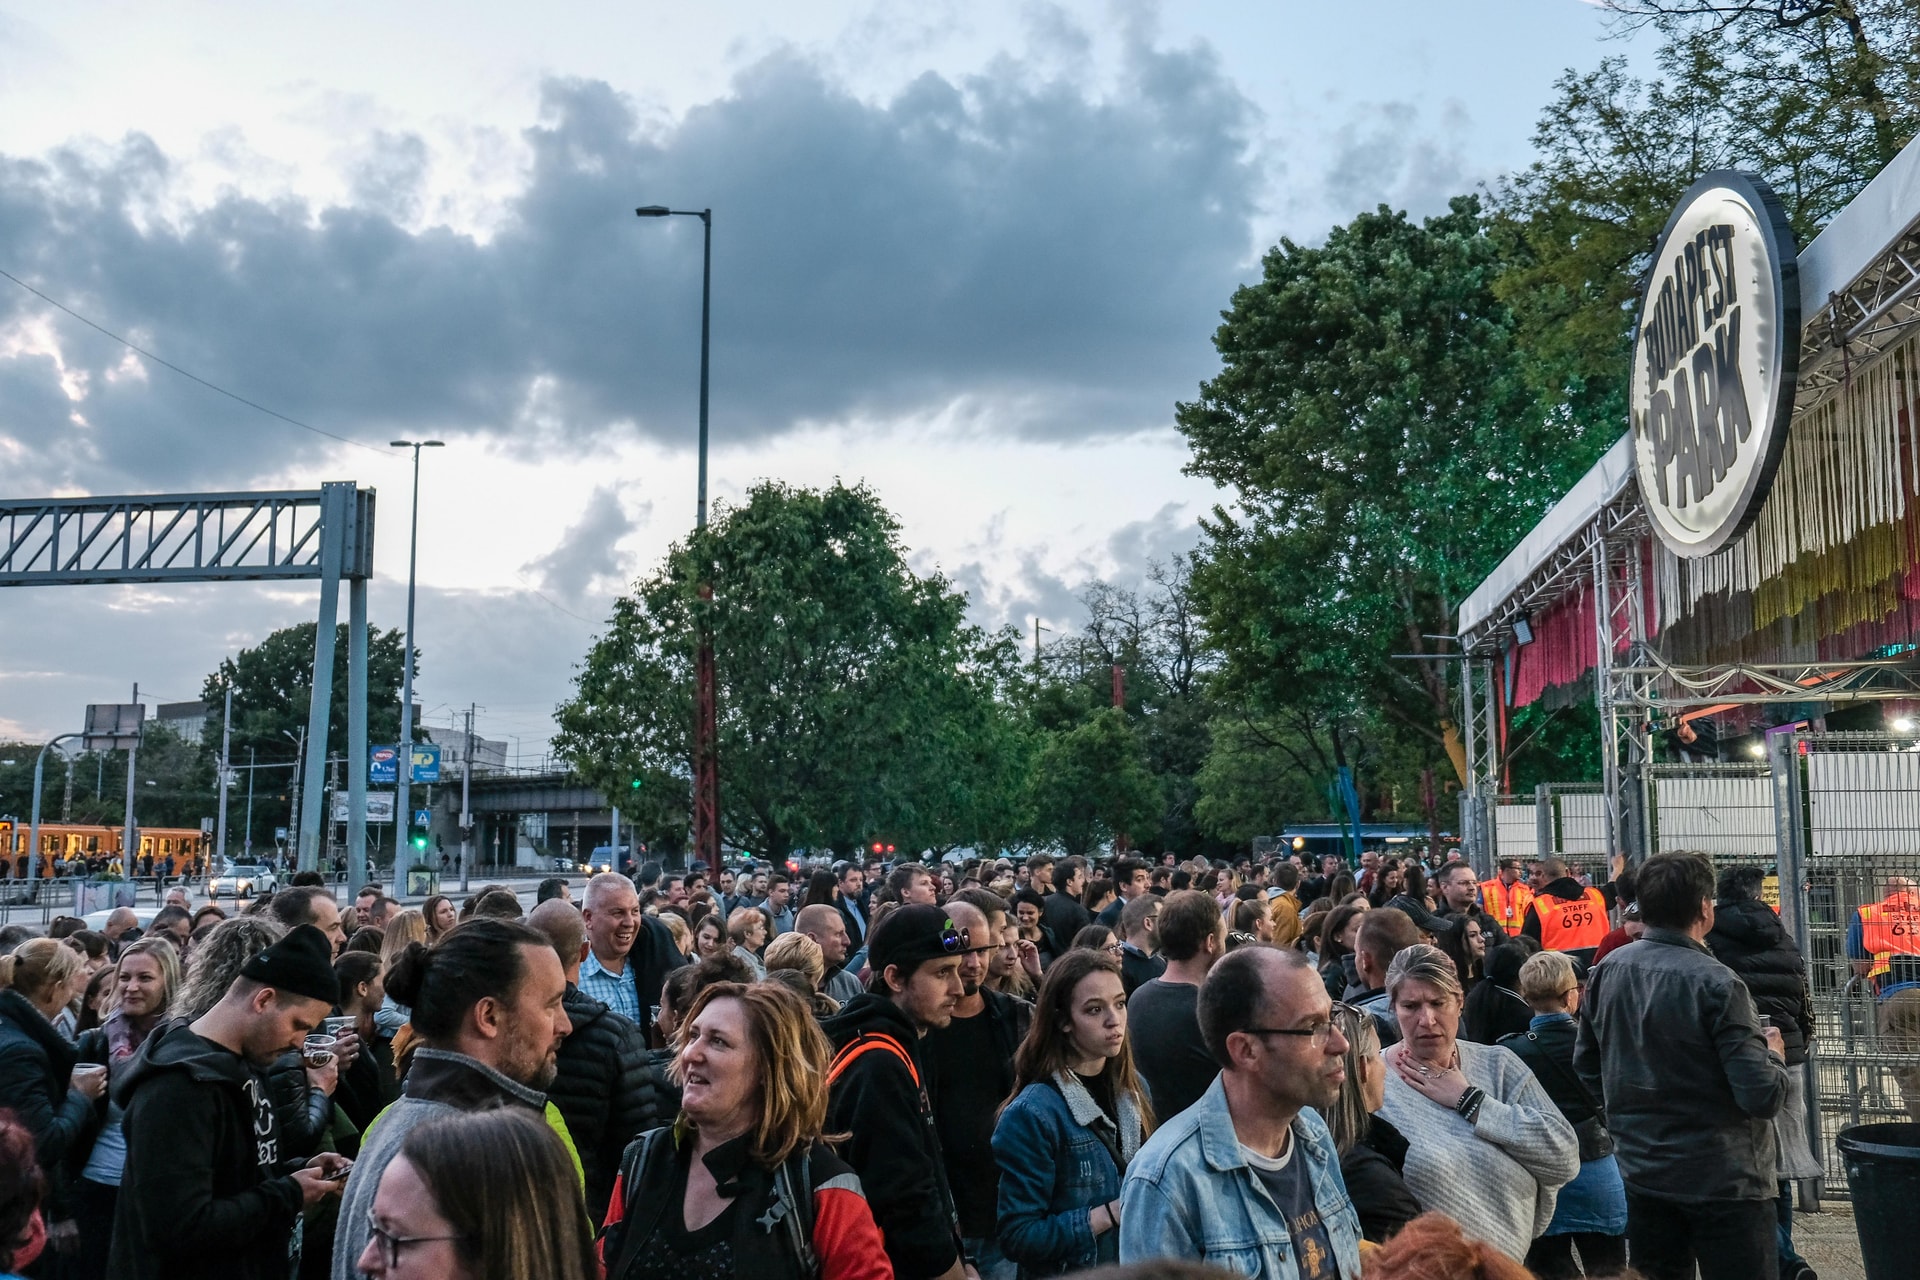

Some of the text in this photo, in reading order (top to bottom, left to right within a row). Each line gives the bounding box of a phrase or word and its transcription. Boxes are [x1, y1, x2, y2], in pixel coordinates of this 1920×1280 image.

[1644, 224, 1737, 395] BUDAPEST
[1649, 305, 1752, 509] PARK
[1562, 903, 1589, 913] STAFF
[1562, 911, 1593, 929] 699
